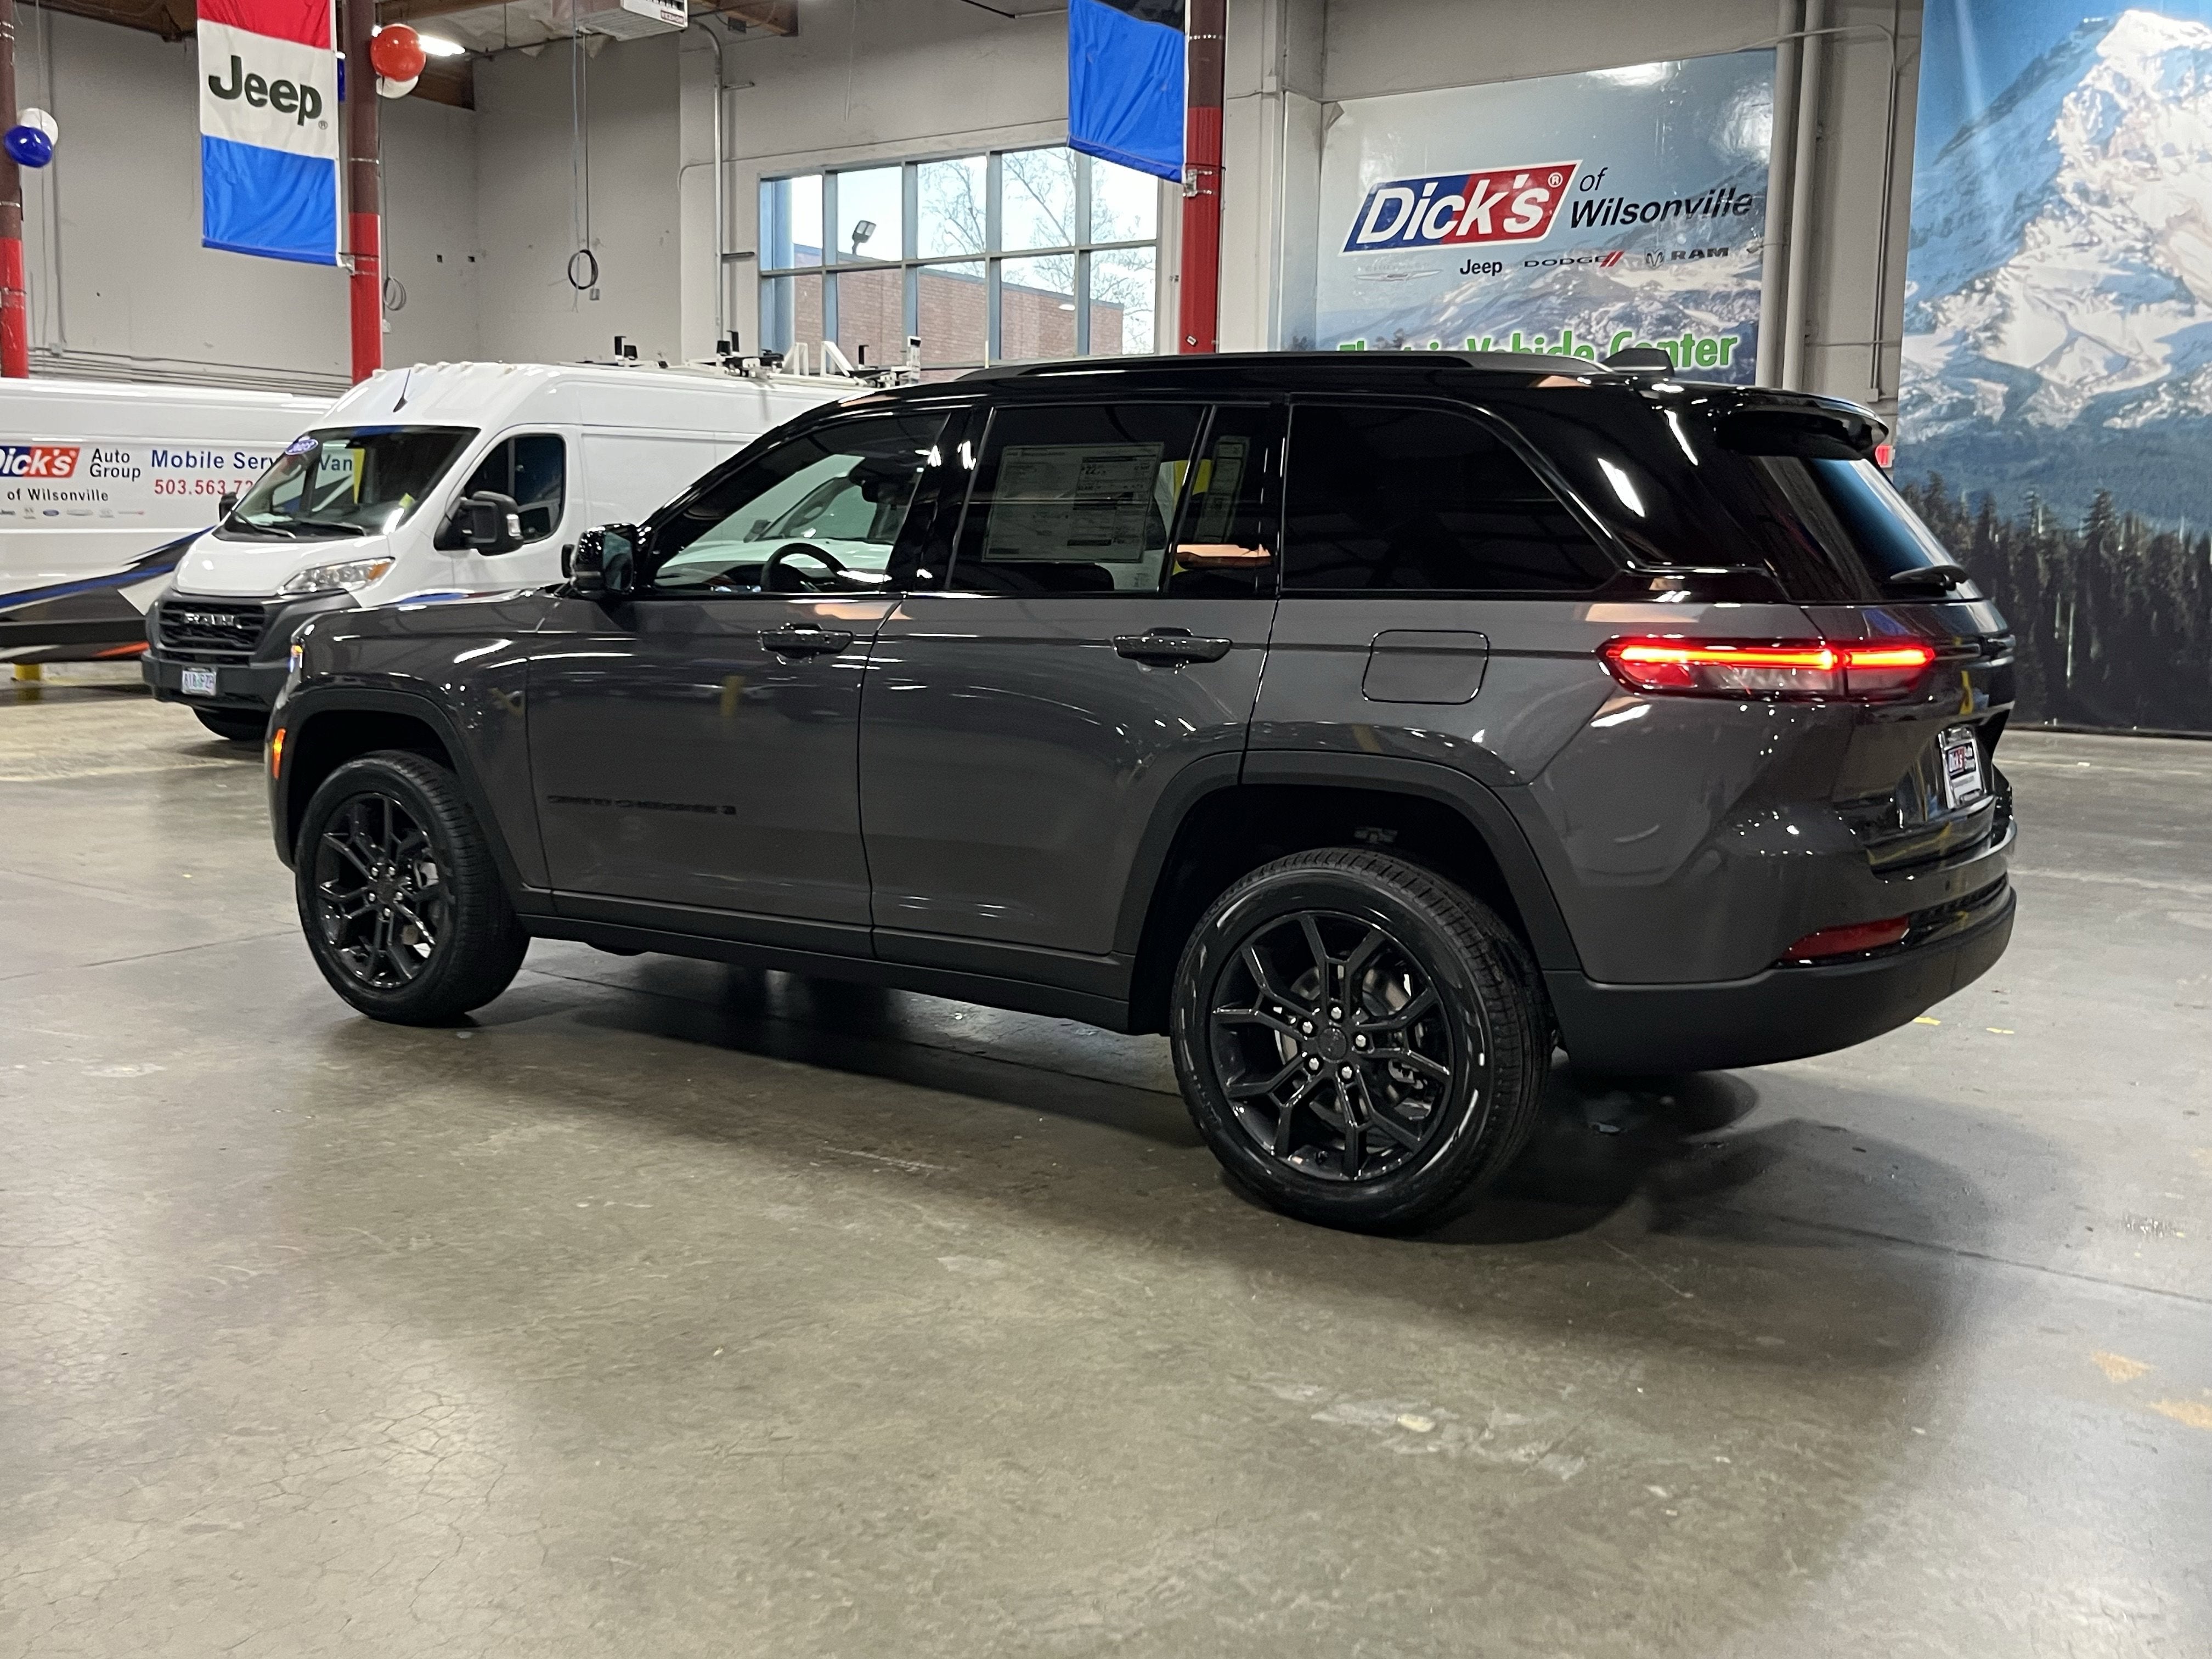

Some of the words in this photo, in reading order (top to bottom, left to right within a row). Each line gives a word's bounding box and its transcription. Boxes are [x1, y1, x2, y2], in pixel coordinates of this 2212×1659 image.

[208, 54, 322, 127] Jeep
[1356, 174, 1550, 244] Dick's
[1579, 167, 1609, 191] of
[1570, 188, 1753, 229] Wilsonville
[1460, 259, 1503, 276] Jeep
[1524, 256, 1610, 267] DODGE
[1671, 247, 1729, 260] RAM
[1610, 331, 1738, 368] Cnter
[92, 448, 130, 462] Auto
[151, 450, 224, 469] Mobile
[319, 454, 353, 471] Van
[90, 463, 140, 481] Group
[7, 488, 21, 500] of
[28, 488, 109, 501] Wilsonville
